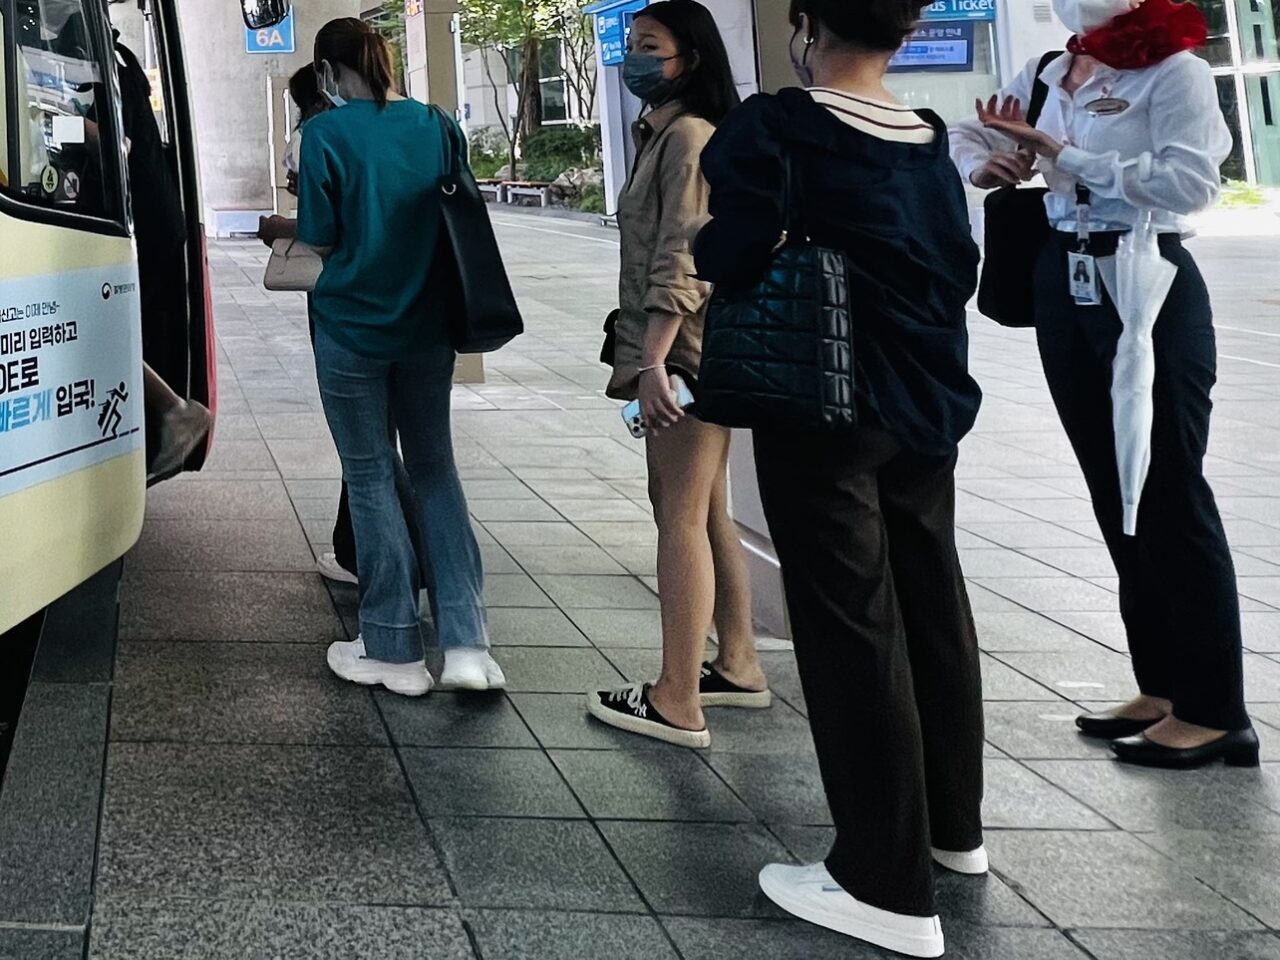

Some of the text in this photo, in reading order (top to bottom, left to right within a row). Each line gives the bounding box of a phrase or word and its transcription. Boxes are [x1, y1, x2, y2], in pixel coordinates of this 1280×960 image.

[256, 28, 284, 47] 6A
[25, 302, 41, 318] 이제
[0, 330, 26, 356] 미리
[29, 321, 78, 350] 입력하고
[56, 378, 96, 418] 입국!
